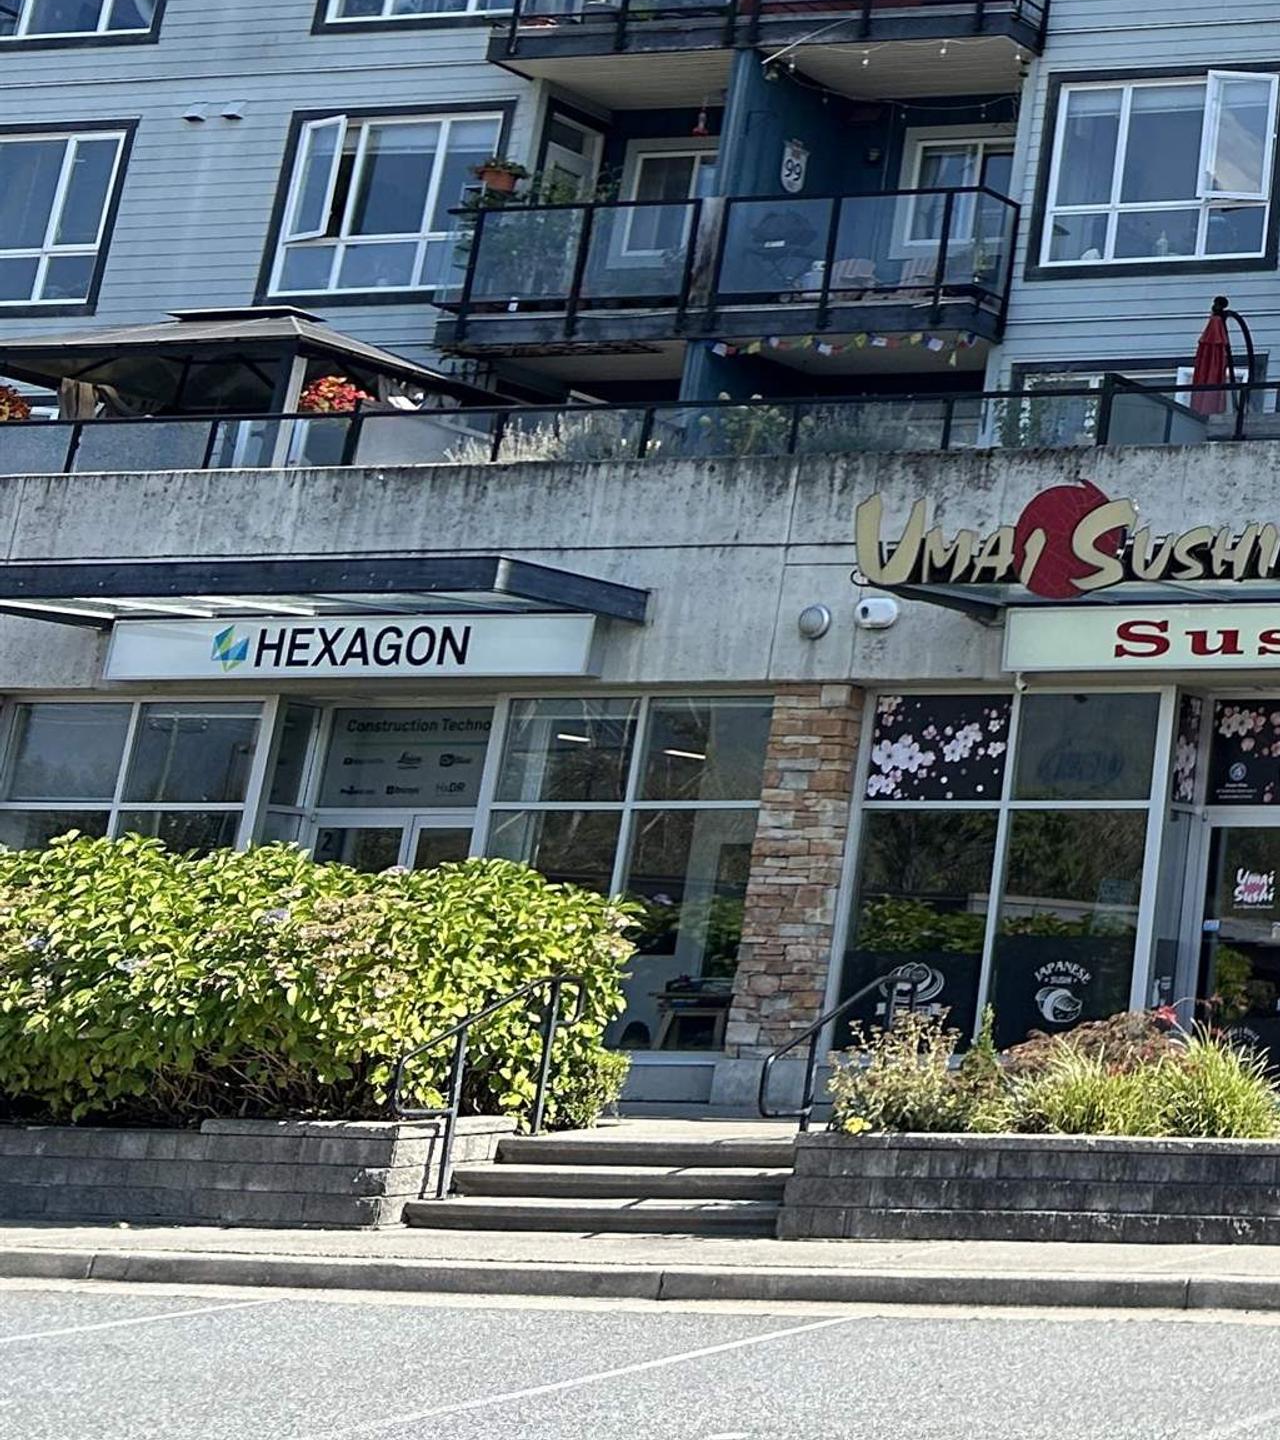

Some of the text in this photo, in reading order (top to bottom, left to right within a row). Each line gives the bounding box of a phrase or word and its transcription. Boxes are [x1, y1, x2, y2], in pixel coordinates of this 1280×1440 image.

[784, 159, 802, 181] 99
[856, 492, 1047, 585] UMAI
[1069, 497, 1280, 590] SUSHI
[254, 626, 471, 667] HEXAGON
[347, 719, 438, 733] Construction
[321, 831, 333, 851] 2
[1034, 960, 1092, 985] JAPANESE
